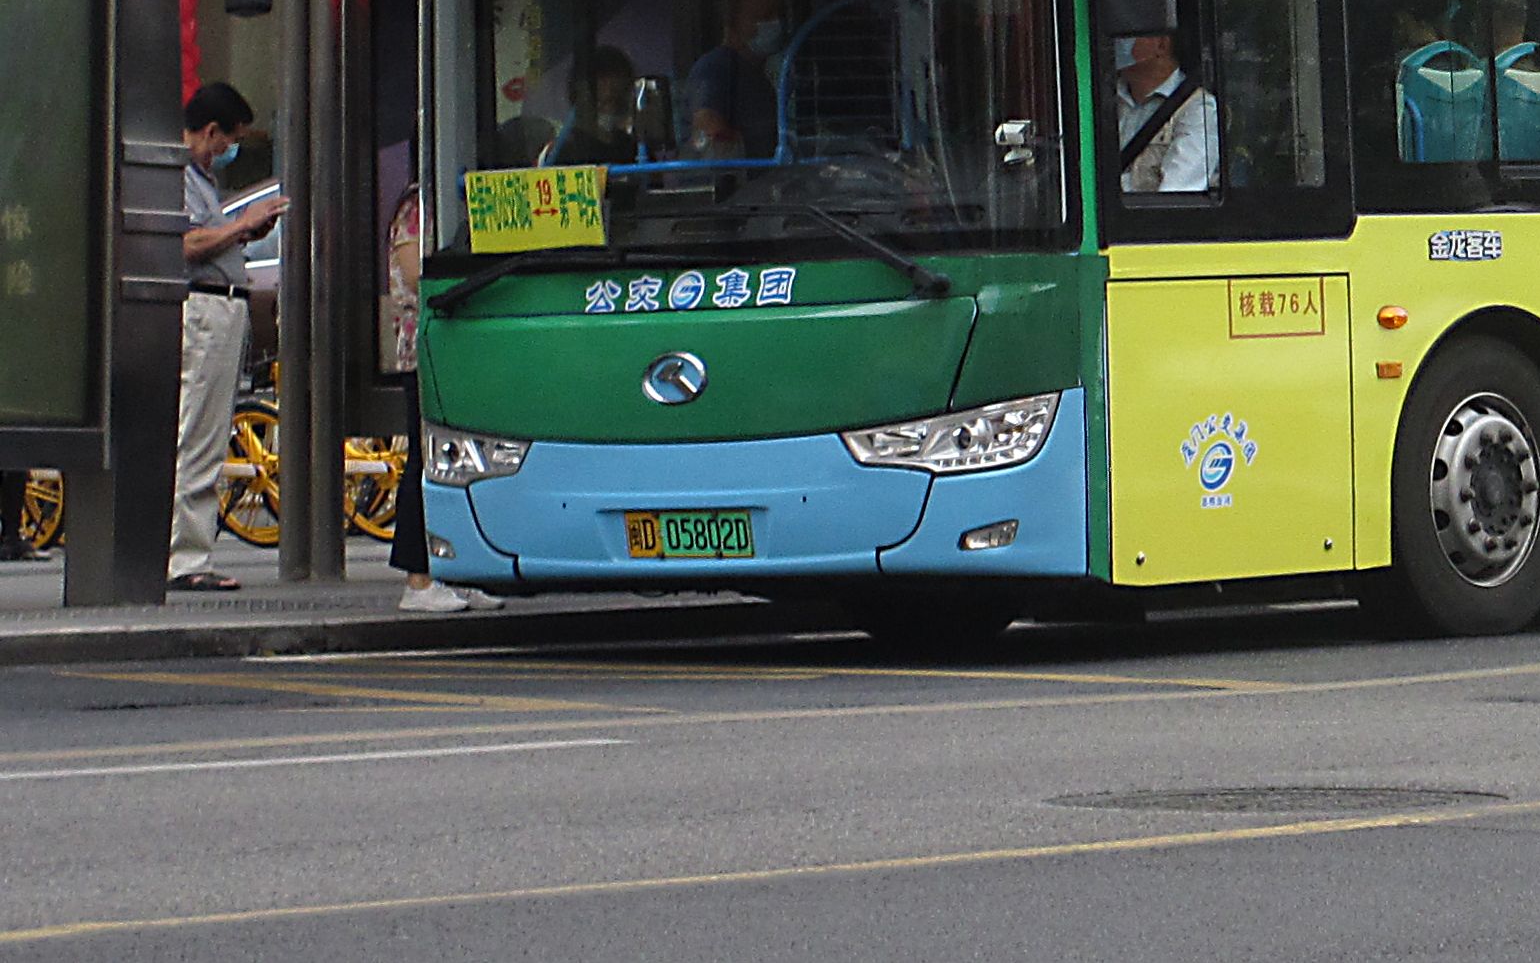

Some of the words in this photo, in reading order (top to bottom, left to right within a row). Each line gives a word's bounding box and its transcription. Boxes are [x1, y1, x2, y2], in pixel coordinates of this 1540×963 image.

[536, 179, 552, 206] 19
[1429, 231, 1503, 259] 金龙客车
